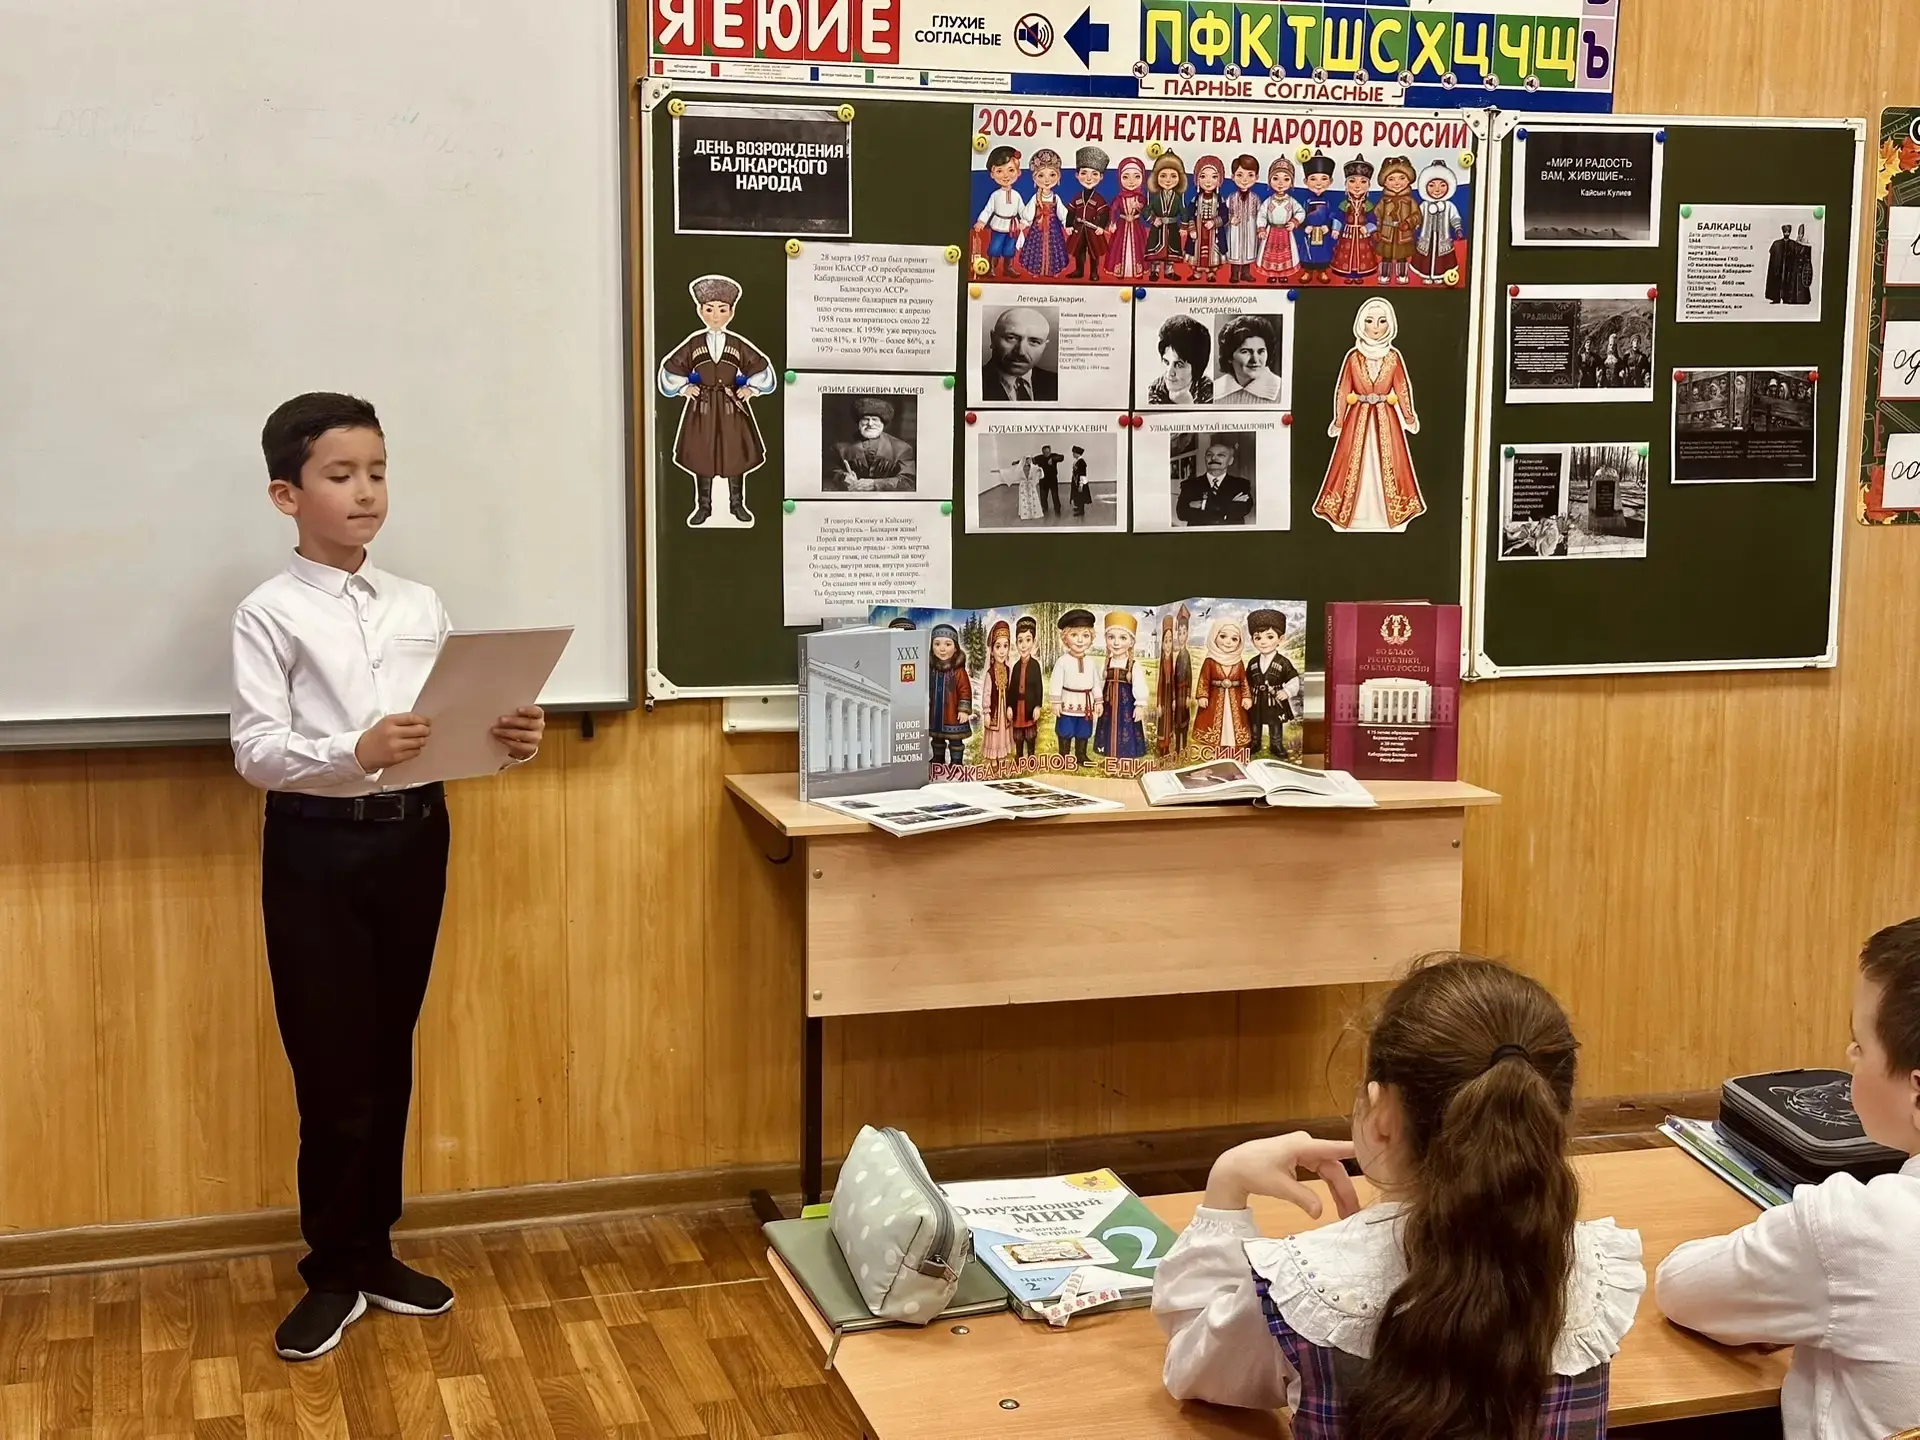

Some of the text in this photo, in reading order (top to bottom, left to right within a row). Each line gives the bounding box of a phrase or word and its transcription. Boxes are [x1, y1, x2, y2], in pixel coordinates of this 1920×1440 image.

[931, 14, 985, 30] ГЛУХИЕ
[914, 30, 1002, 47] СОГЛАСНЫЕ
[1582, 30, 1610, 79] Ъ
[1164, 79, 1384, 103] ПАРНЫЕ СОГЛАСНЫЕ
[1113, 112, 1242, 143] ЕДИНСТВА
[1252, 117, 1363, 148] НАРОДОВ
[1373, 121, 1468, 149] РОССИИ
[693, 139, 844, 159] ДЕНЬ ВОЗРОЖДЕНИЯ
[710, 156, 828, 175] БАЛКАРСКОГО
[1546, 158, 1633, 168] «МИР И РАДОСТЬ
[1541, 171, 1565, 182] ВАМ,
[736, 174, 803, 192] НАРОДА
[1580, 188, 1632, 198] Кайсын Кулиев
[1697, 222, 1751, 232] БАЛКАРЦЫ
[820, 253, 830, 261] 28
[831, 255, 852, 263] марта
[854, 253, 870, 261] 1957
[903, 257, 929, 265] принят
[813, 263, 833, 271] Закон
[835, 264, 867, 272] КБАССР
[814, 274, 864, 283] Кабардинской
[866, 275, 887, 283] АССР
[840, 285, 909, 294] Балкарскую АССР»
[862, 296, 898, 305] балкарцев
[909, 298, 934, 306] родину
[1016, 294, 1048, 304] Легенда
[1174, 296, 1258, 304] ТАНЗИЛЯ ЗУМАКУЛОВА
[905, 308, 931, 316] апрелю
[1189, 306, 1242, 314] МУСТАФАЕВНА
[818, 315, 834, 323] 1958
[921, 317, 930, 325] 22
[886, 328, 900, 336] уже
[817, 345, 833, 353] 1979
[862, 346, 878, 354] 90%
[895, 346, 931, 357] балкарцев
[817, 385, 925, 394] КЯЗИМ БЕККИЕВИЧ МЕЧИЕВ
[988, 424, 1108, 433] КУДАЕВ МУХТАР ЧУКАЕВИЧ
[1149, 421, 1275, 432] УЛЬБАШЕВ МУТАЙ ИСМАИЛОВИЧ
[895, 719, 921, 730] НОВОЕ
[895, 742, 921, 753] НОВЫЕ
[892, 753, 923, 764] ВЫЗОВЫ
[928, 762, 995, 782] РУЖБА
[998, 753, 1078, 778] НАРОДОВ
[953, 1197, 1104, 1217] Окружающий
[1009, 1209, 1086, 1225] МИР
[1035, 1228, 1082, 1238] тетрадь
[1102, 1225, 1162, 1270] 2
[1025, 1282, 1041, 1291] 2
